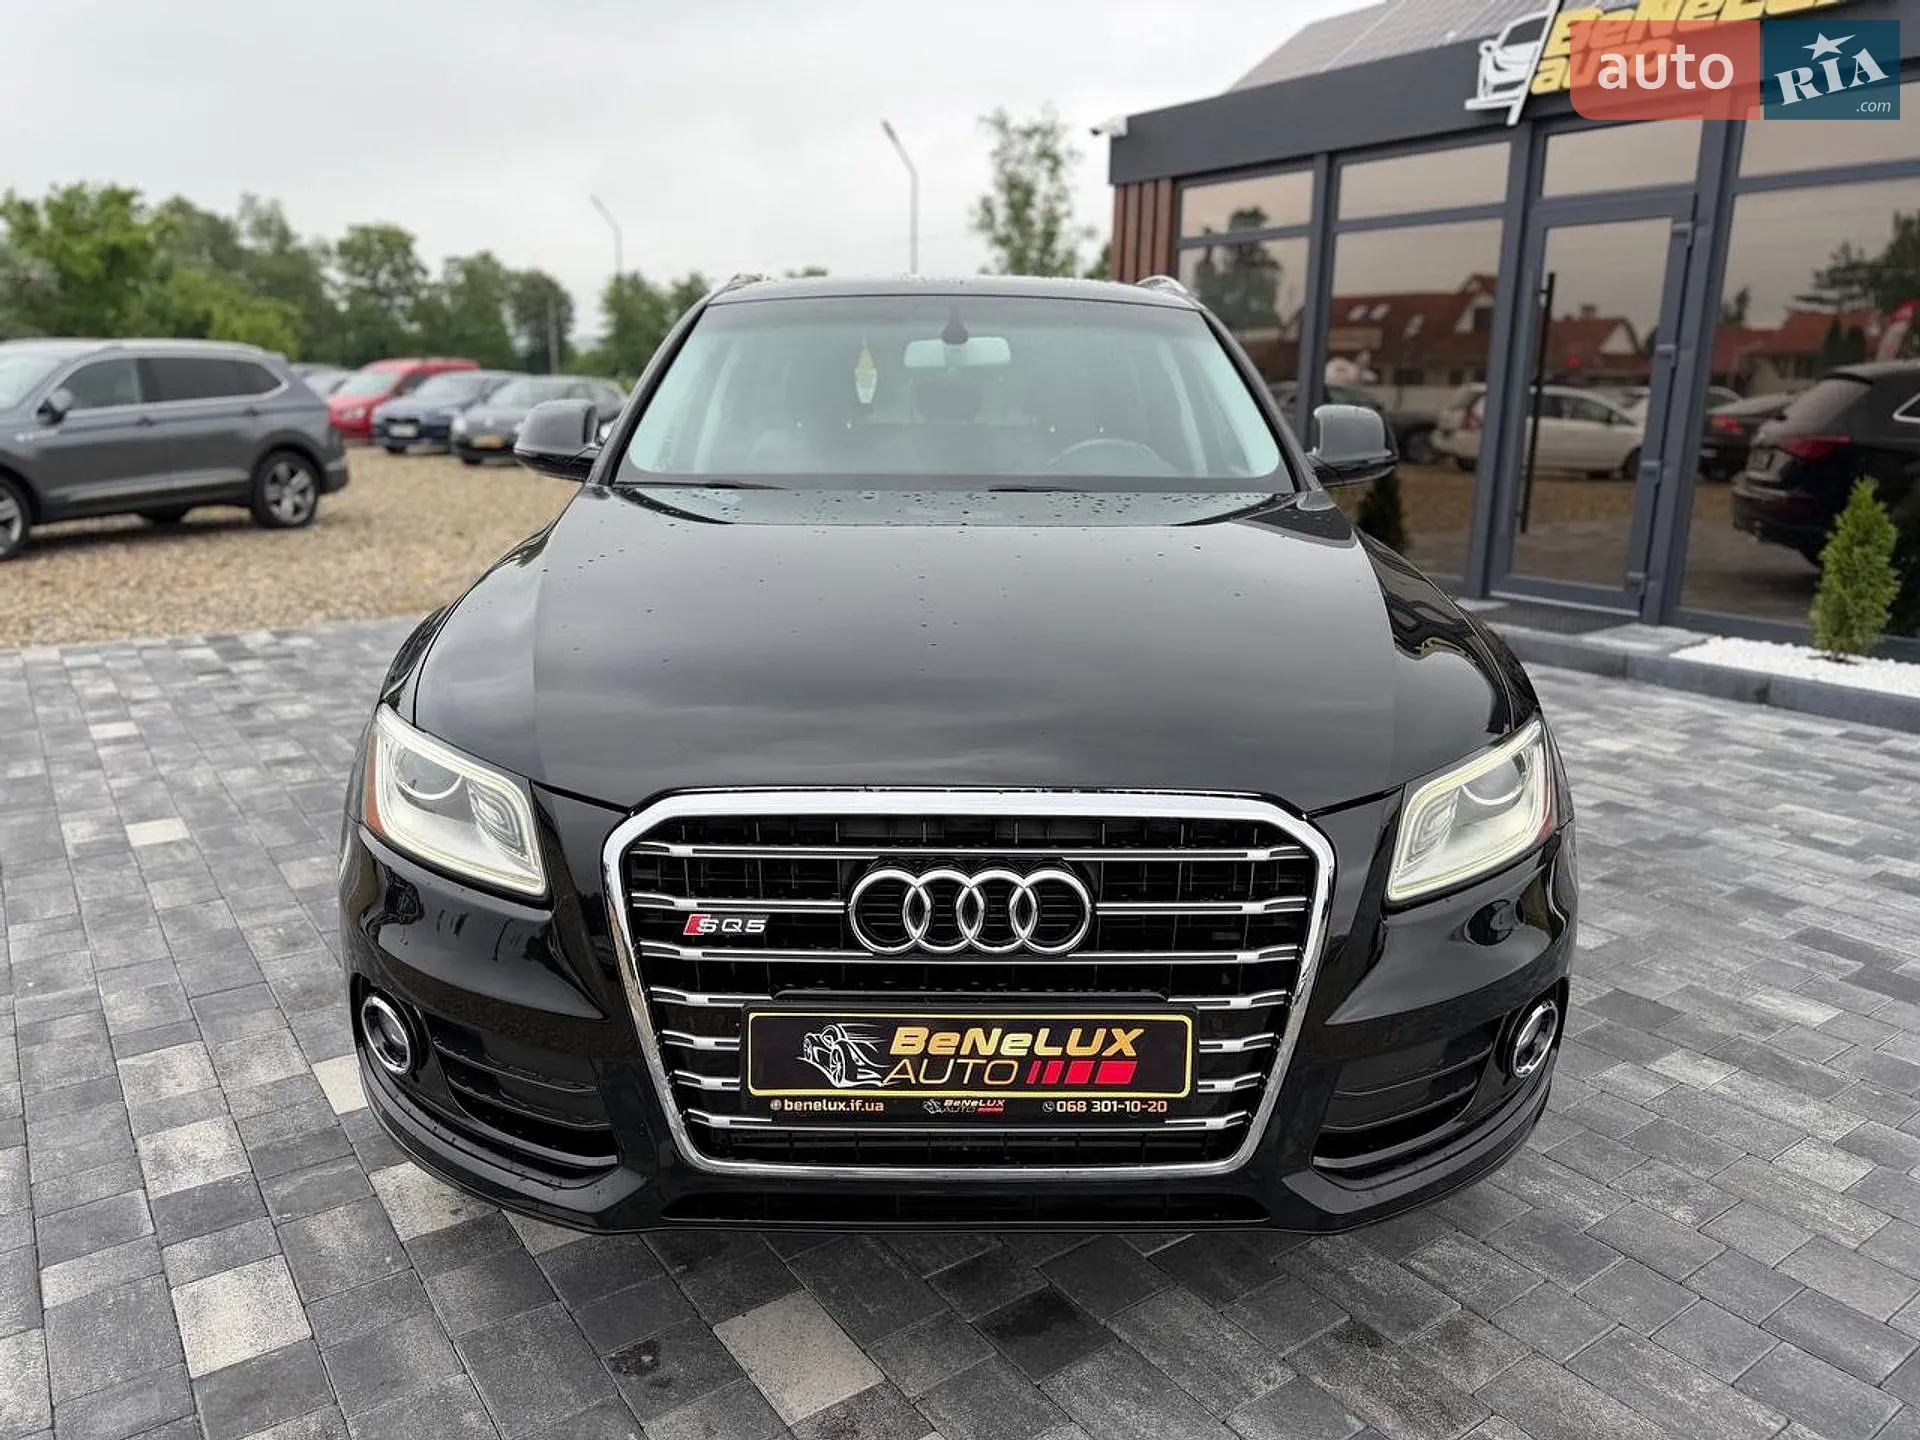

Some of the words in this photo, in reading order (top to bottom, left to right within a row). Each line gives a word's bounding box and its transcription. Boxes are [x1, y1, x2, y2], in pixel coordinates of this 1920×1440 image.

[697, 918, 767, 933] SQ5
[889, 1027, 1145, 1057] BeNeLUX
[881, 1058, 1019, 1085] AUTO
[783, 1099, 885, 1112] benelux.if.ua
[1056, 1100, 1087, 1112] 068
[1091, 1100, 1168, 1112] 301-10-20
